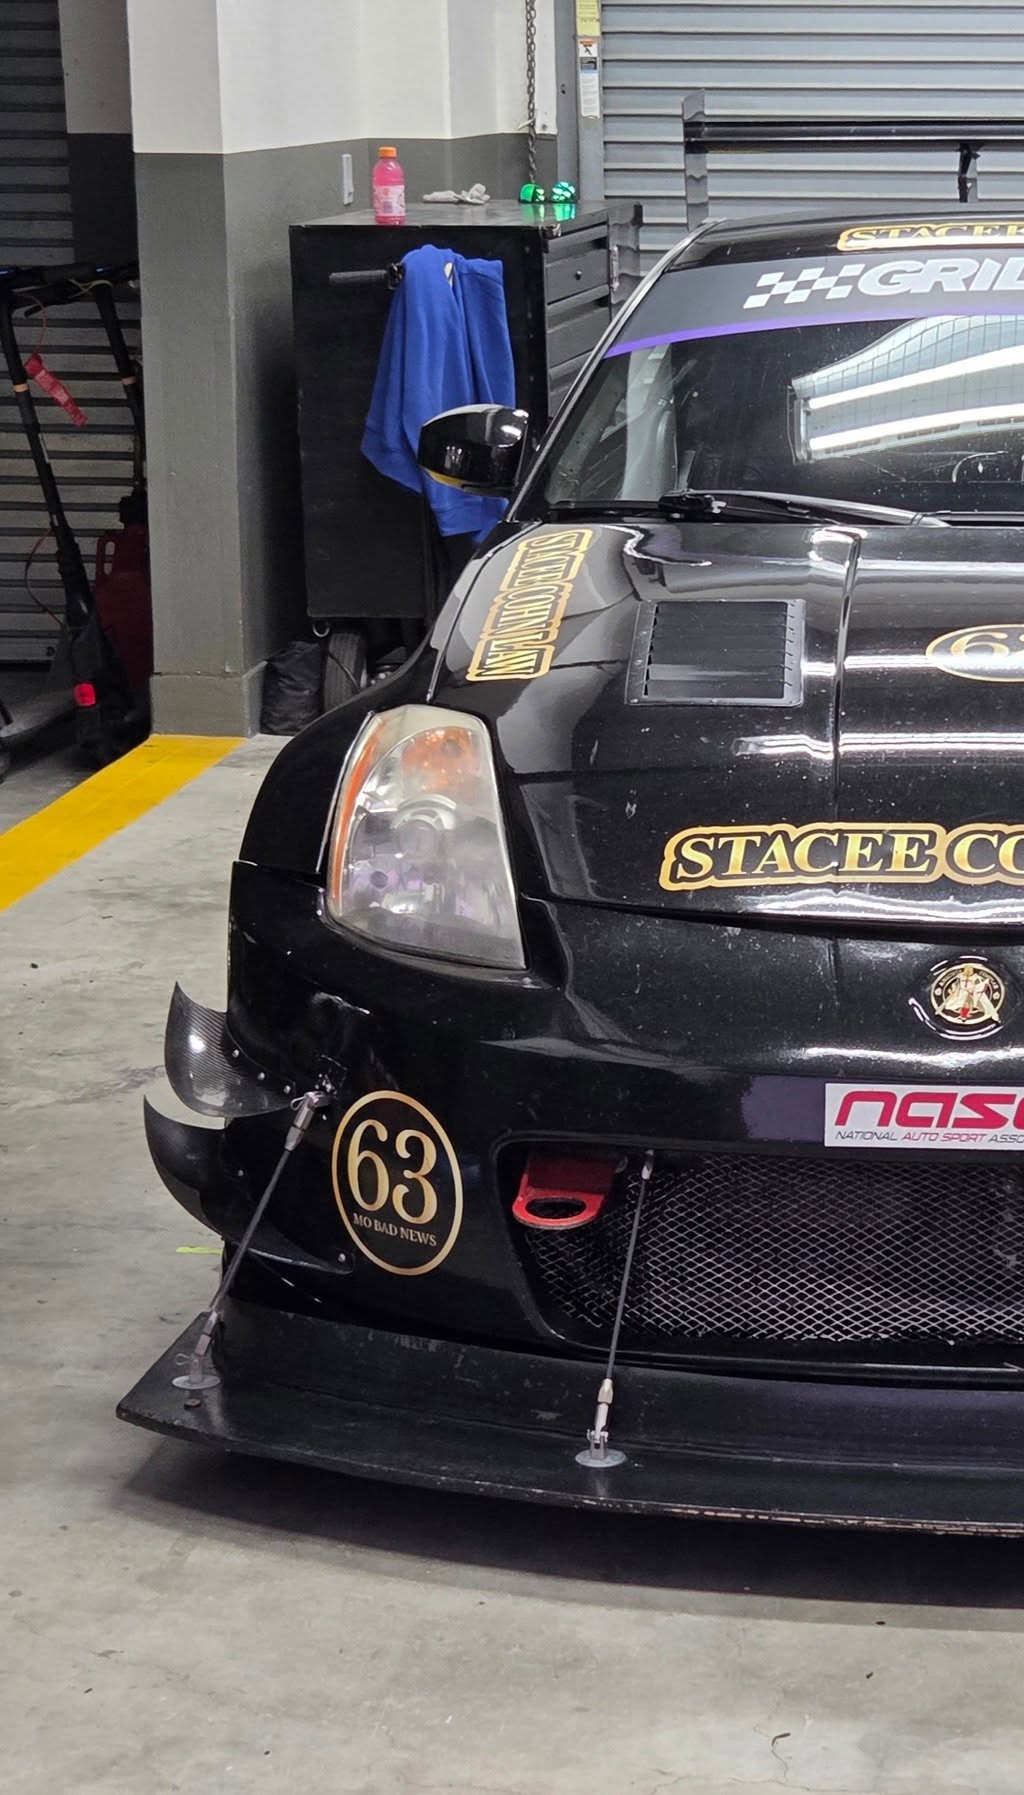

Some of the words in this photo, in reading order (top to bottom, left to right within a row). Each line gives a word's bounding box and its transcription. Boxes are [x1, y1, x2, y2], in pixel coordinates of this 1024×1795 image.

[513, 533, 579, 587] STACEE
[494, 584, 559, 635] COHN
[477, 632, 544, 676] LAW
[677, 832, 931, 879] STACEE
[835, 1130, 898, 1142] NATIONAL
[901, 1131, 940, 1143] AUTO
[941, 1132, 987, 1144] SPORT
[347, 1118, 438, 1225] 63
[353, 1212, 373, 1228] MO
[374, 1220, 398, 1236] BAD
[399, 1226, 438, 1247] NEWS
